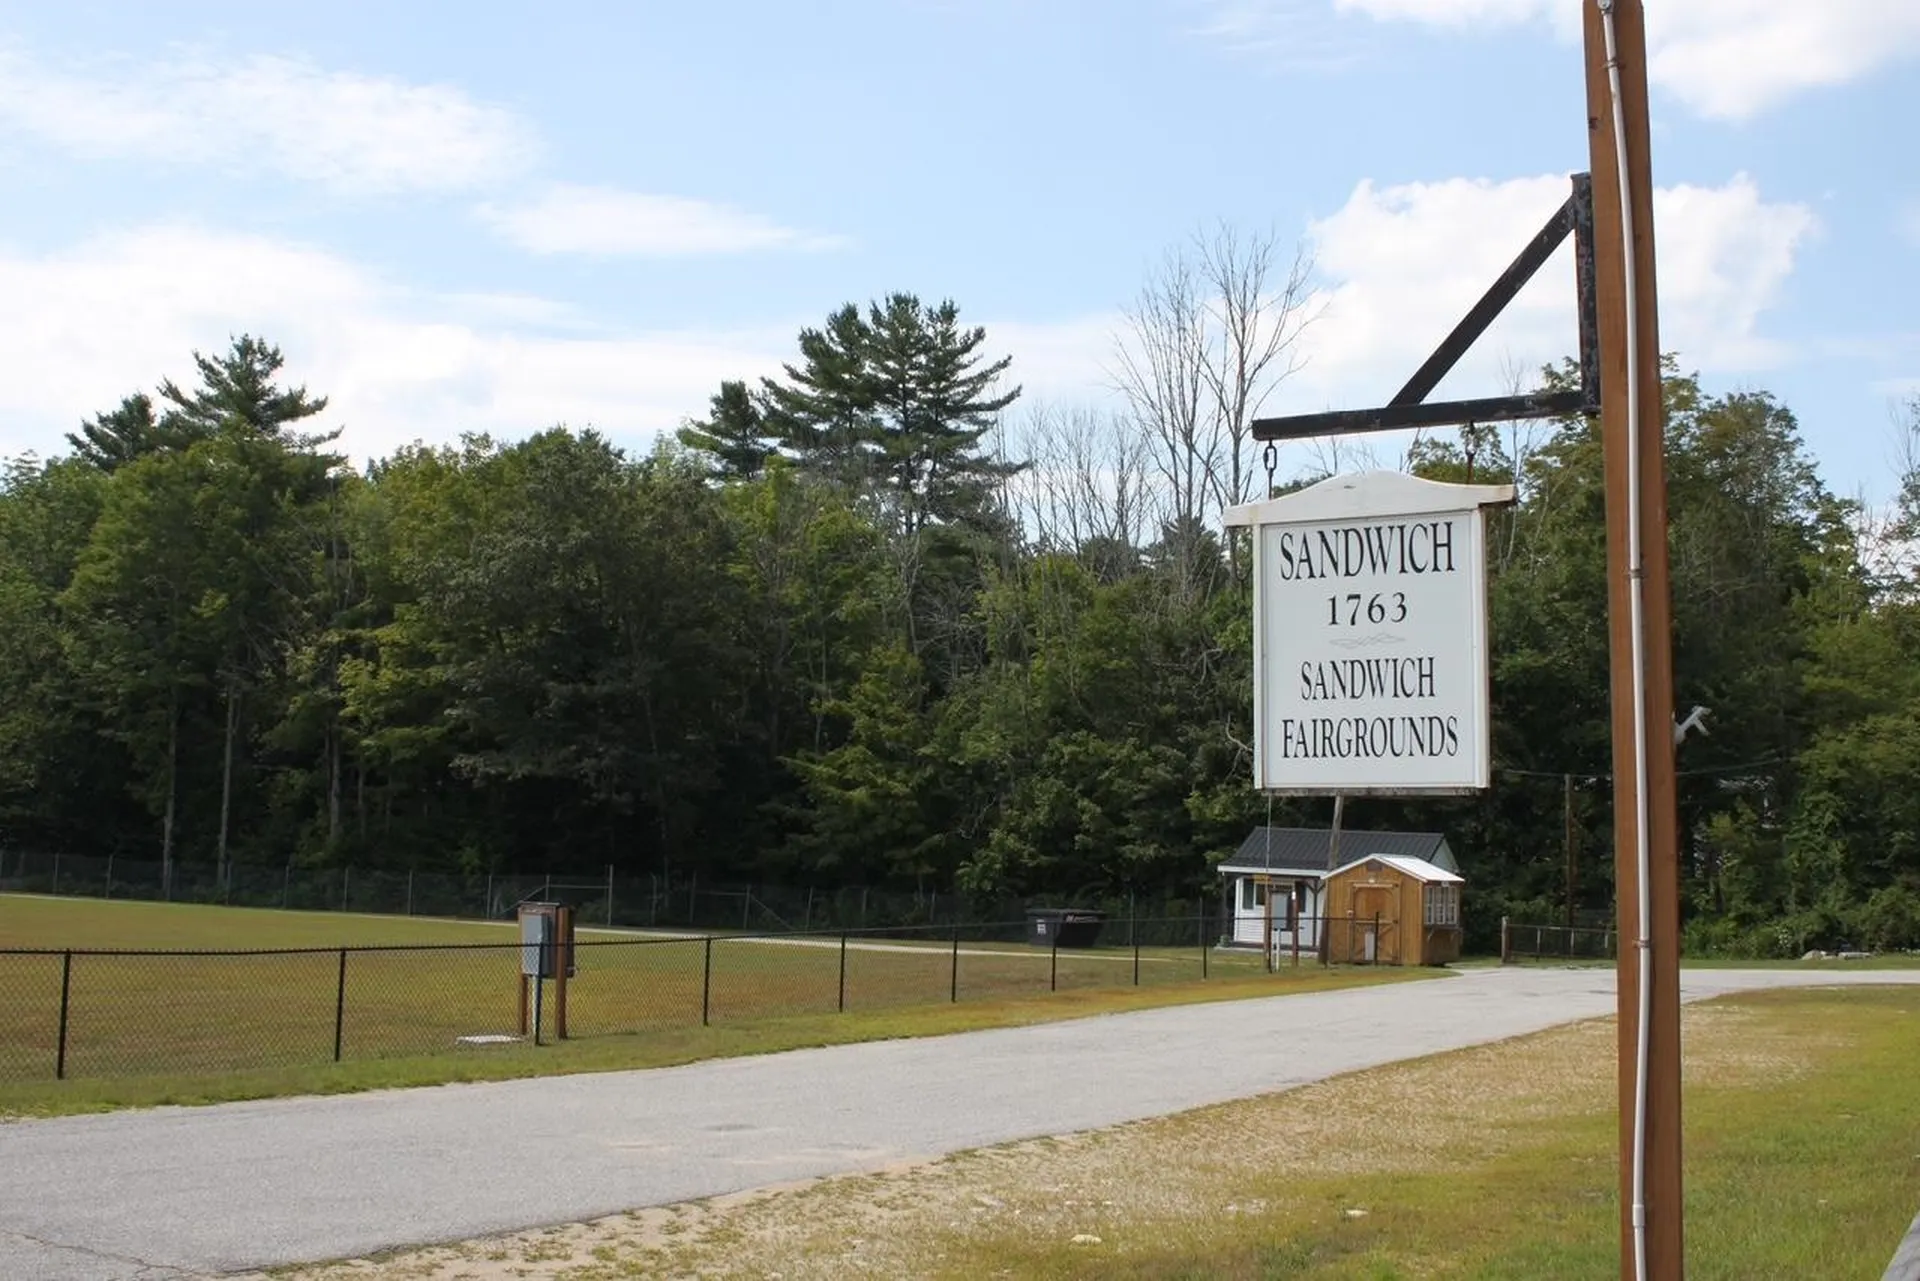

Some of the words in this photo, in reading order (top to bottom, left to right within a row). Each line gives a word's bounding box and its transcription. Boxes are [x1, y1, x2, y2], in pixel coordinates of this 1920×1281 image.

[1280, 522, 1455, 580] SANDWICH
[1327, 592, 1407, 626] 1763
[1301, 657, 1436, 701] SANDWICH
[1282, 715, 1458, 758] FAIRGROUNDS
